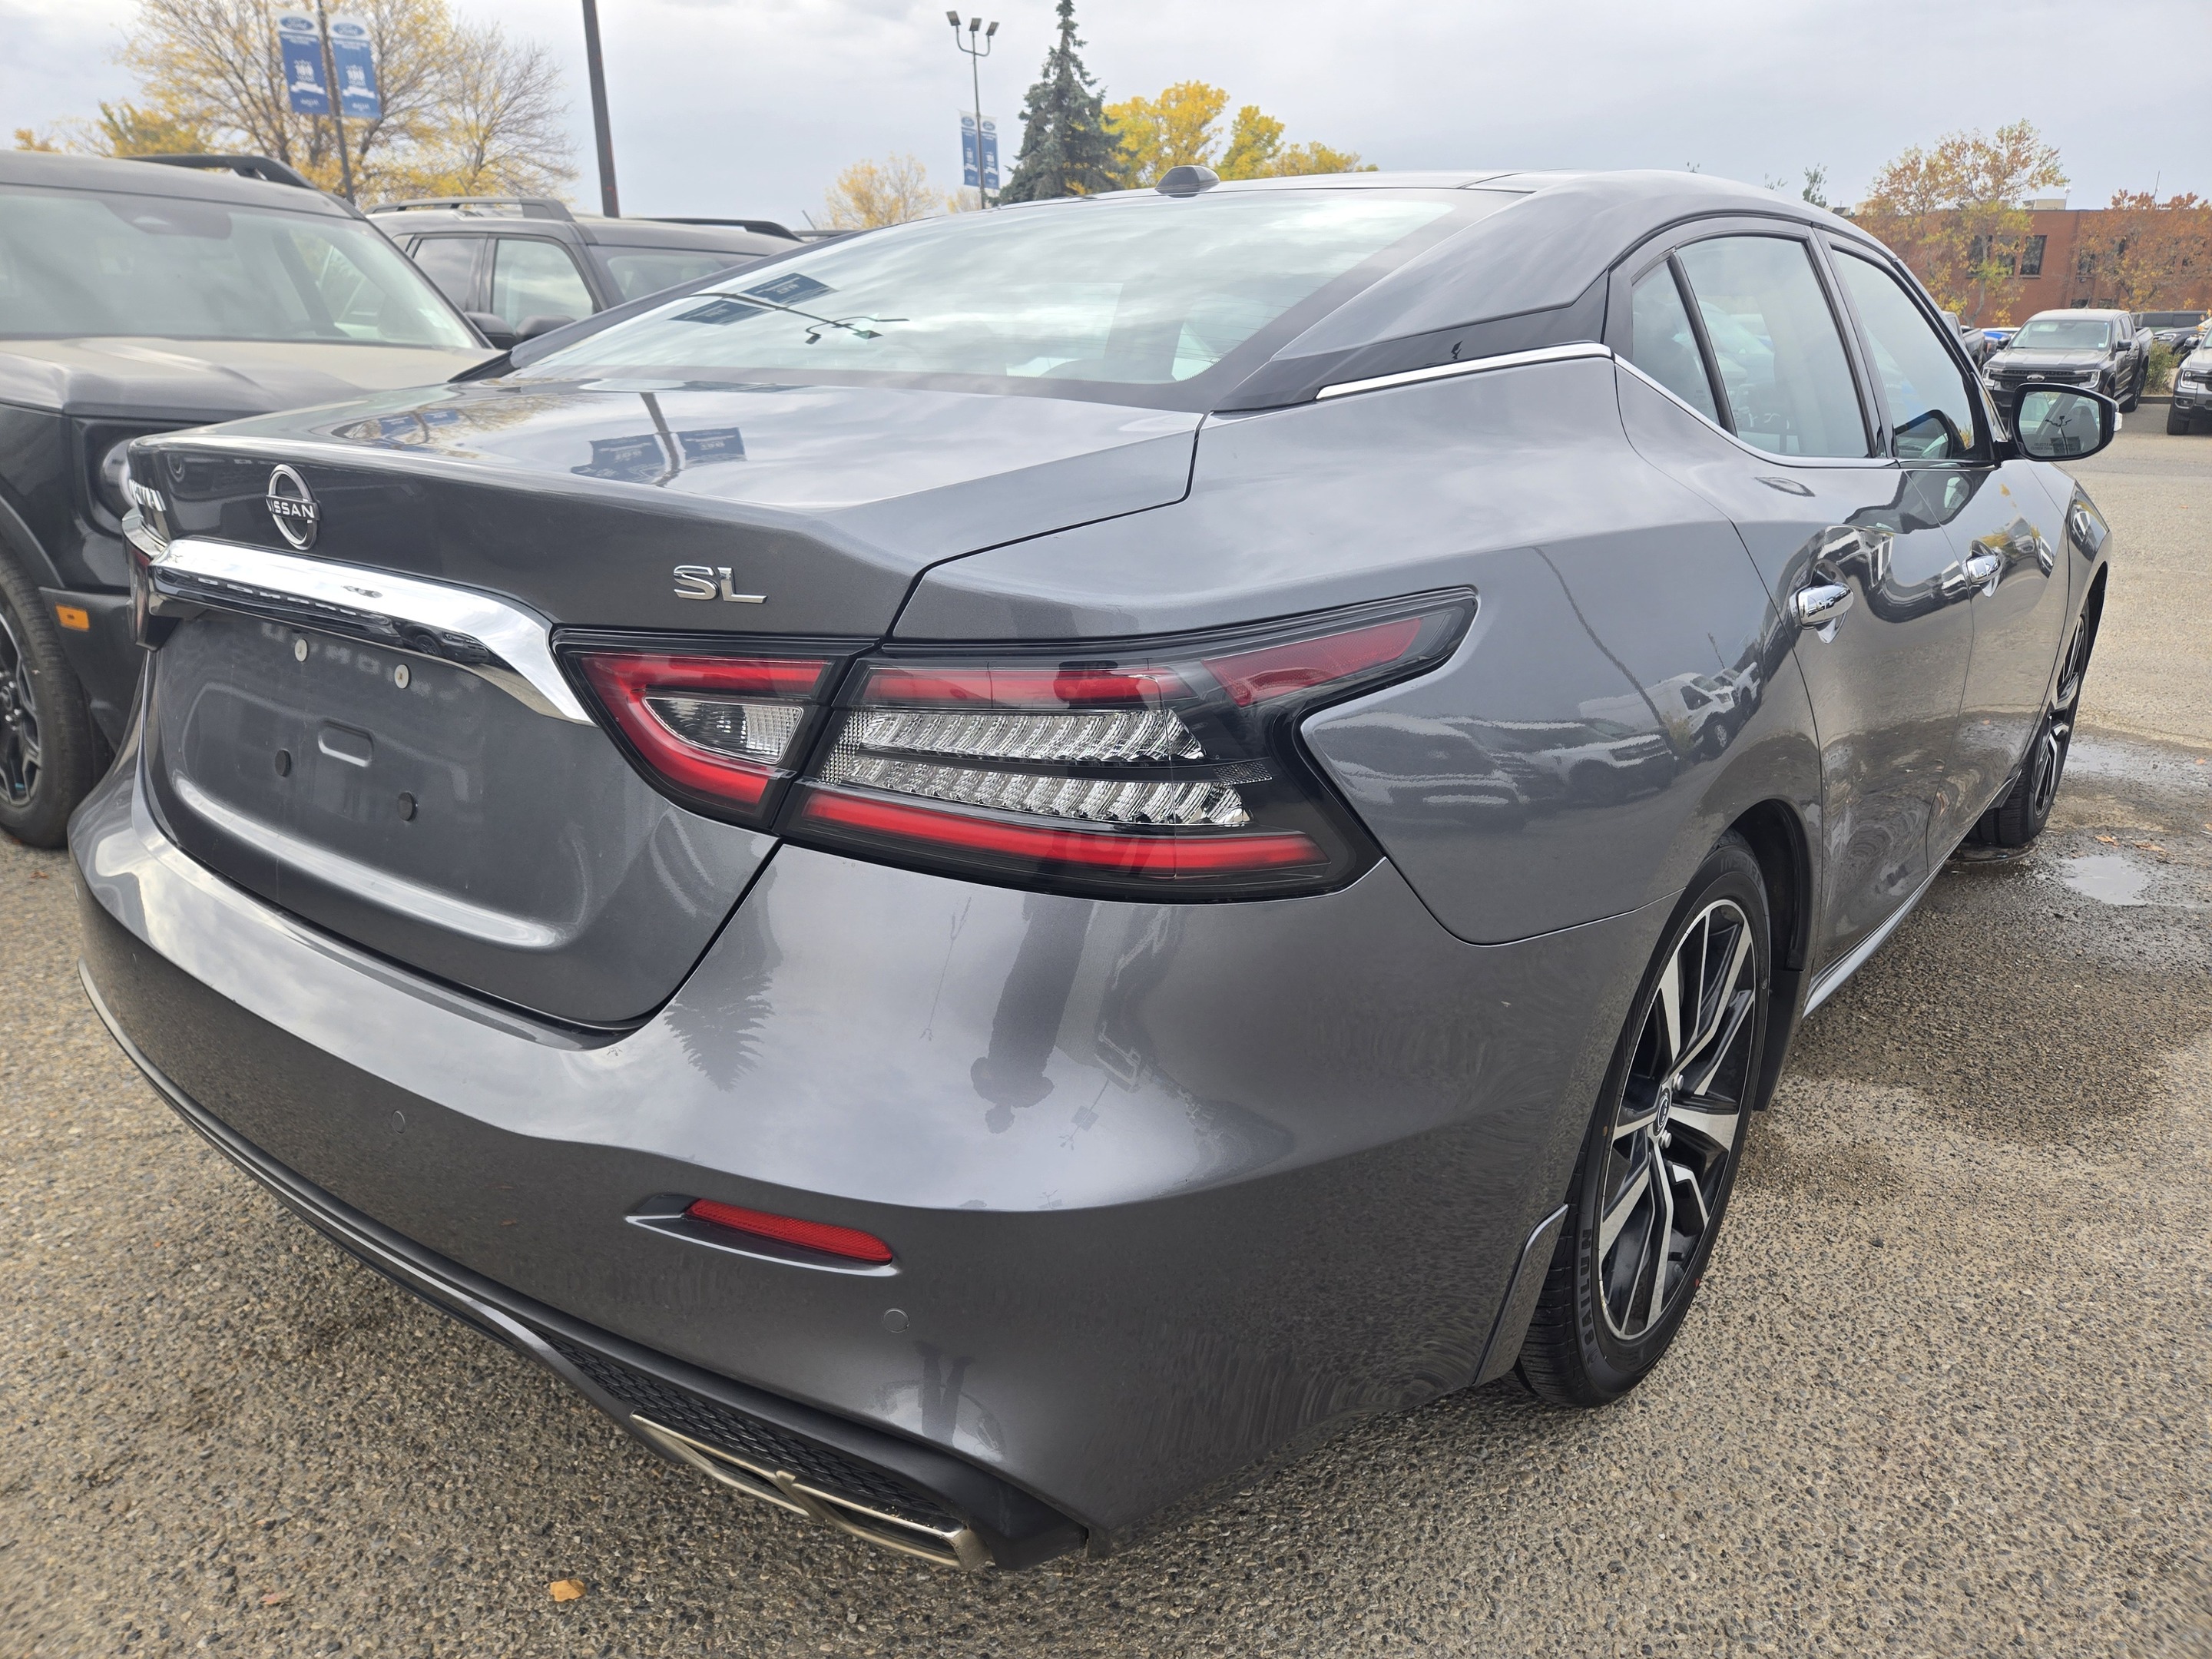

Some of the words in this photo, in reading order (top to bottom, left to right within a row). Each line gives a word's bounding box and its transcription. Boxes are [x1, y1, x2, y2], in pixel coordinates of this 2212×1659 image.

[266, 498, 315, 518] NISSAN
[674, 565, 767, 604] SL
[1580, 1229, 1594, 1346] SAILUN
